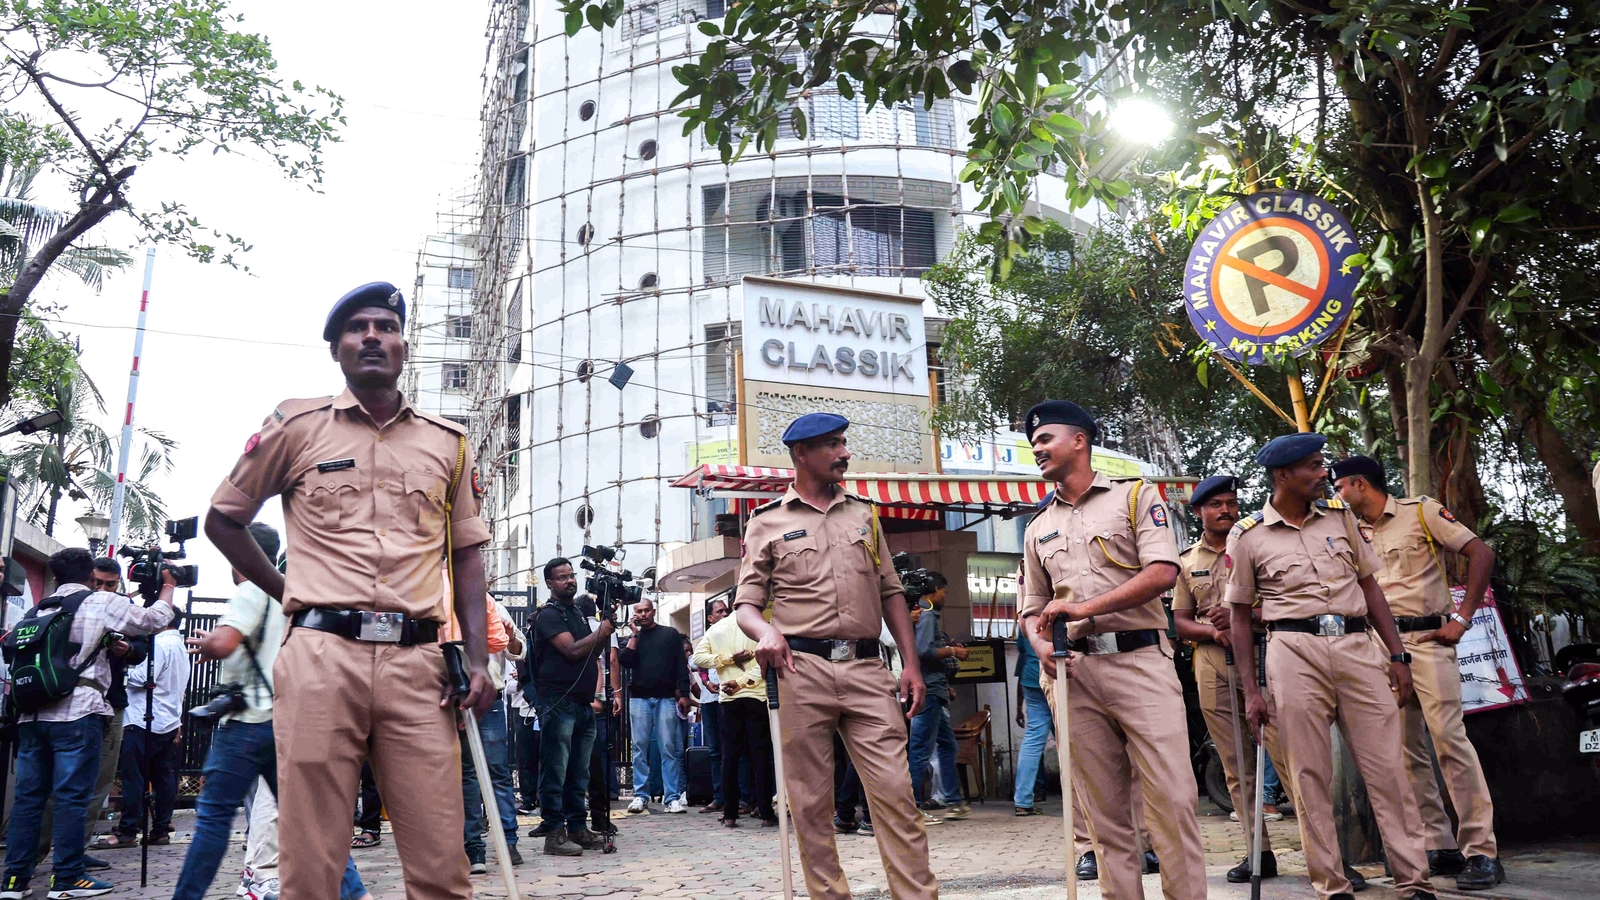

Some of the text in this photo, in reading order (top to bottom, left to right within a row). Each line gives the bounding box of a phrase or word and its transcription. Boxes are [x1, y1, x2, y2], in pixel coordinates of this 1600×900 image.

[1191, 195, 1353, 310] MAHAVIR CLASSIK
[759, 296, 912, 341] MAHAVIR
[760, 338, 915, 379] CLASSIK
[17, 625, 39, 636] TVU
[16, 675, 33, 686] NDTV
